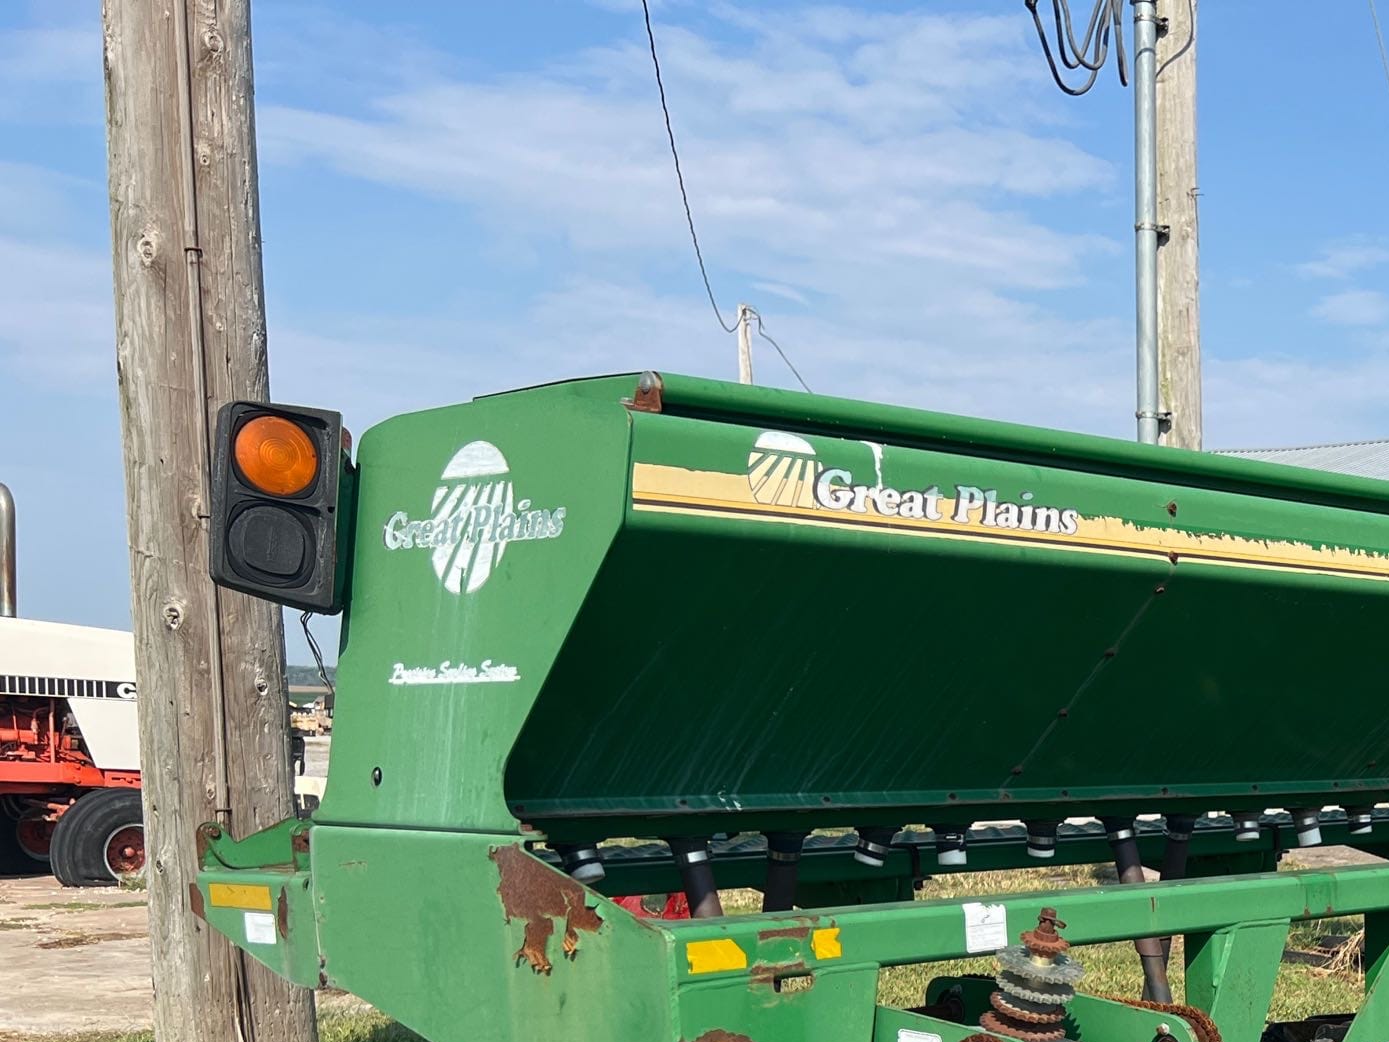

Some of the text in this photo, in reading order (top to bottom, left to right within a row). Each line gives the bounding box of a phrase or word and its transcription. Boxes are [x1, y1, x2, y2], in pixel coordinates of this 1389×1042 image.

[384, 498, 567, 551] Great Plains
[814, 468, 1079, 535] Great Plains
[117, 682, 137, 699] C
